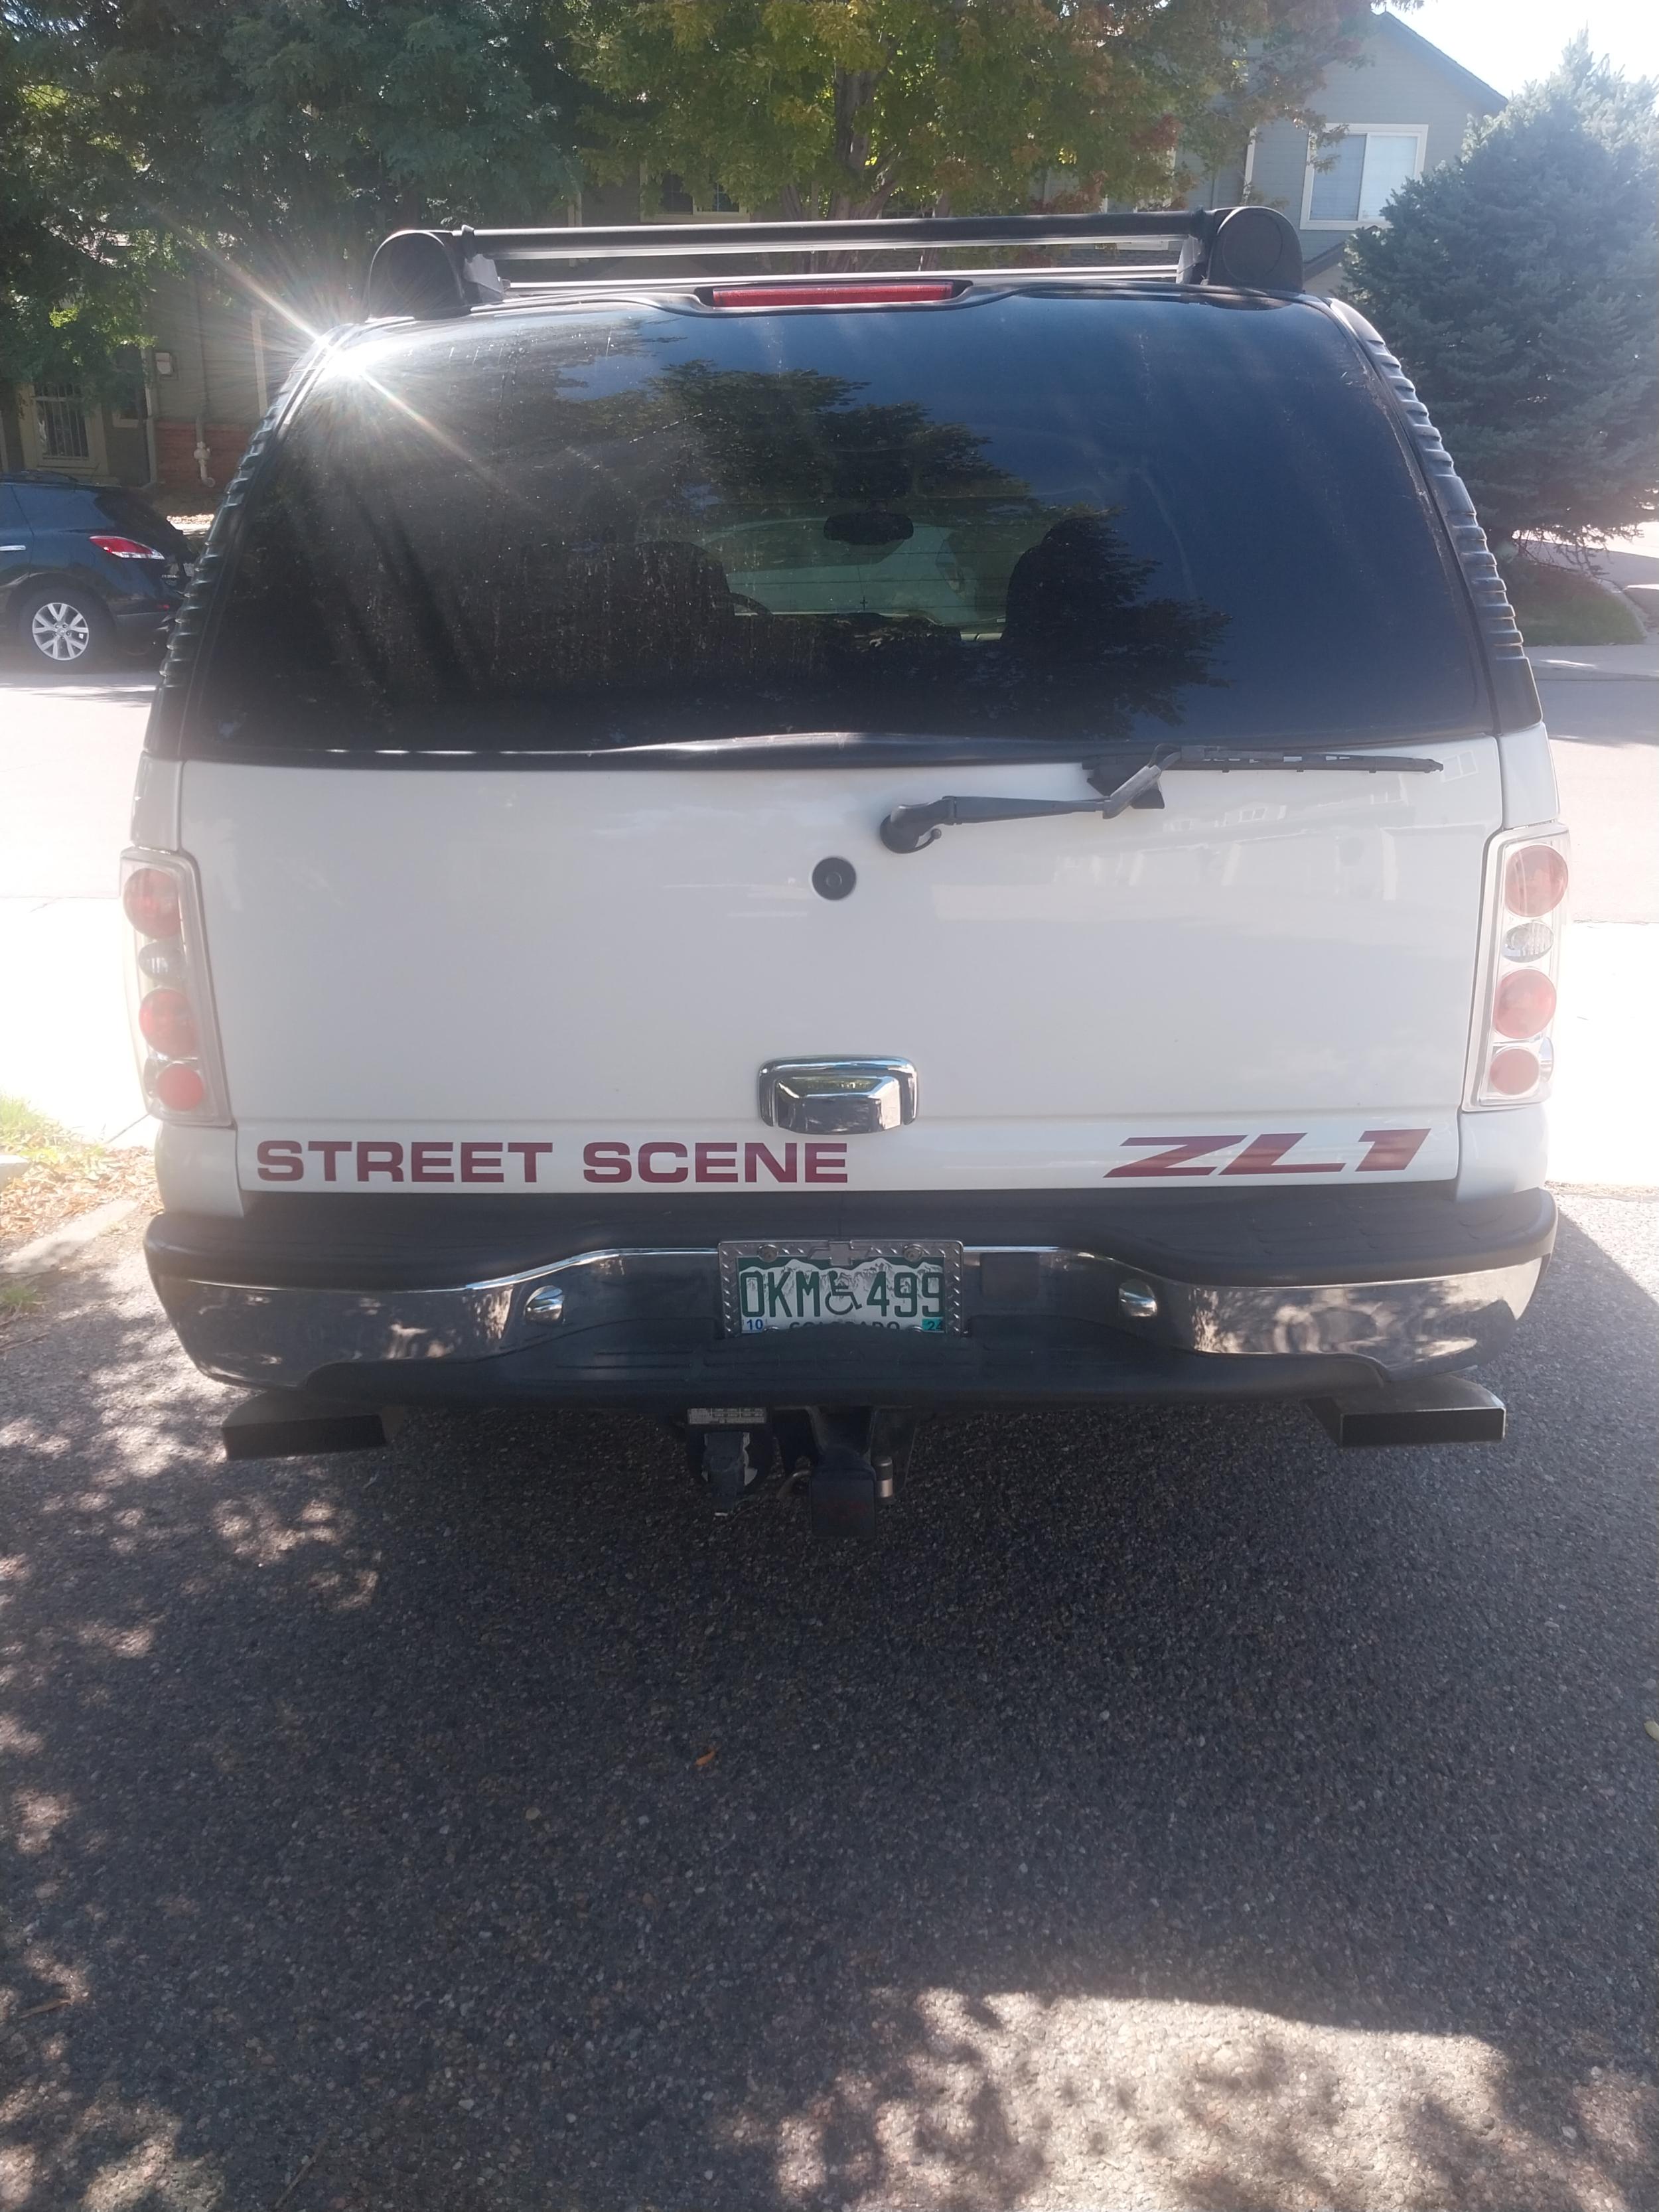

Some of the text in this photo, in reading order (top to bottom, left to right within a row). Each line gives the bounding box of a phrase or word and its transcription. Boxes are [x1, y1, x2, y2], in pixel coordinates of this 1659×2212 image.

[256, 1140, 849, 1184] STREET SCENE
[1102, 1128, 1432, 1179] ZL1
[867, 1271, 945, 1317] 499
[747, 1318, 764, 1331] 10
